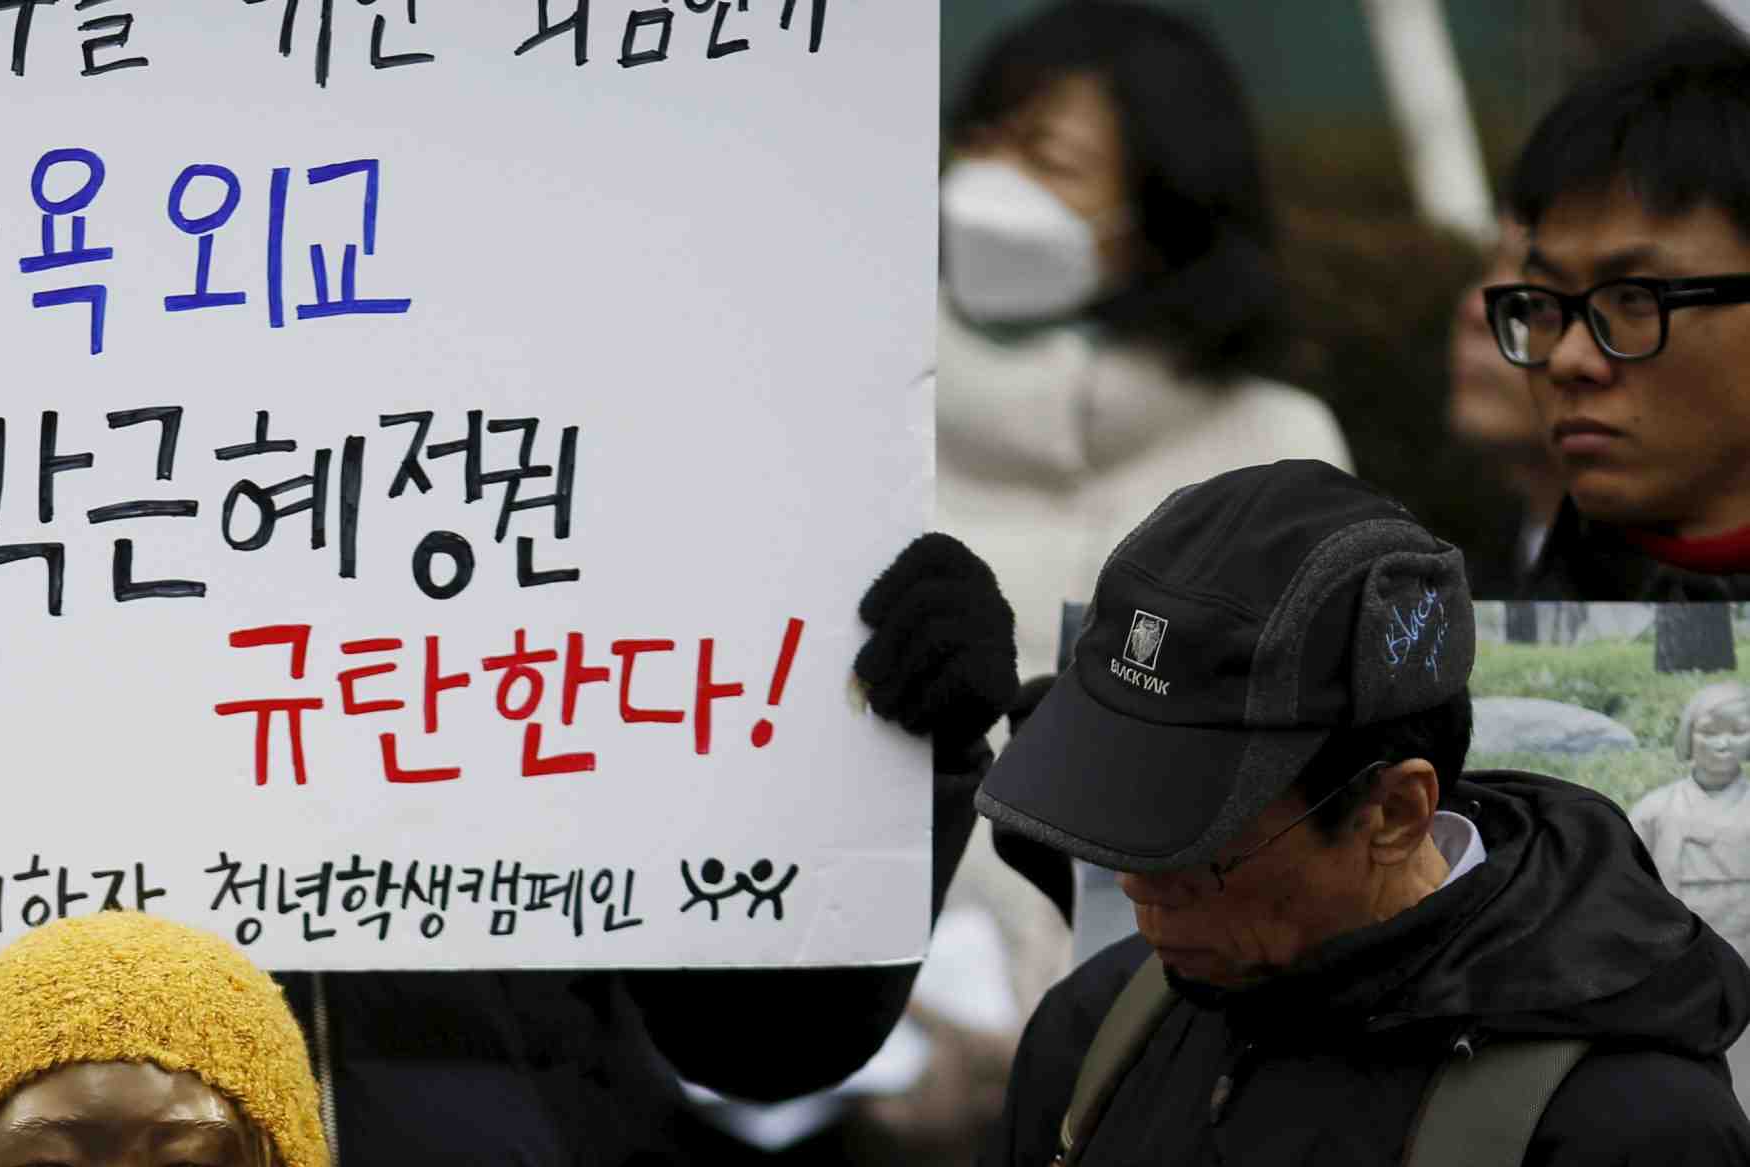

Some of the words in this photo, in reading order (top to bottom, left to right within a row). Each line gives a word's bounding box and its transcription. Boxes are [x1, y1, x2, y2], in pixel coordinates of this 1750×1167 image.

[164, 159, 411, 328] 외교
[214, 618, 805, 786] 규탄한다!
[204, 851, 643, 946] 청년학생캠페인
